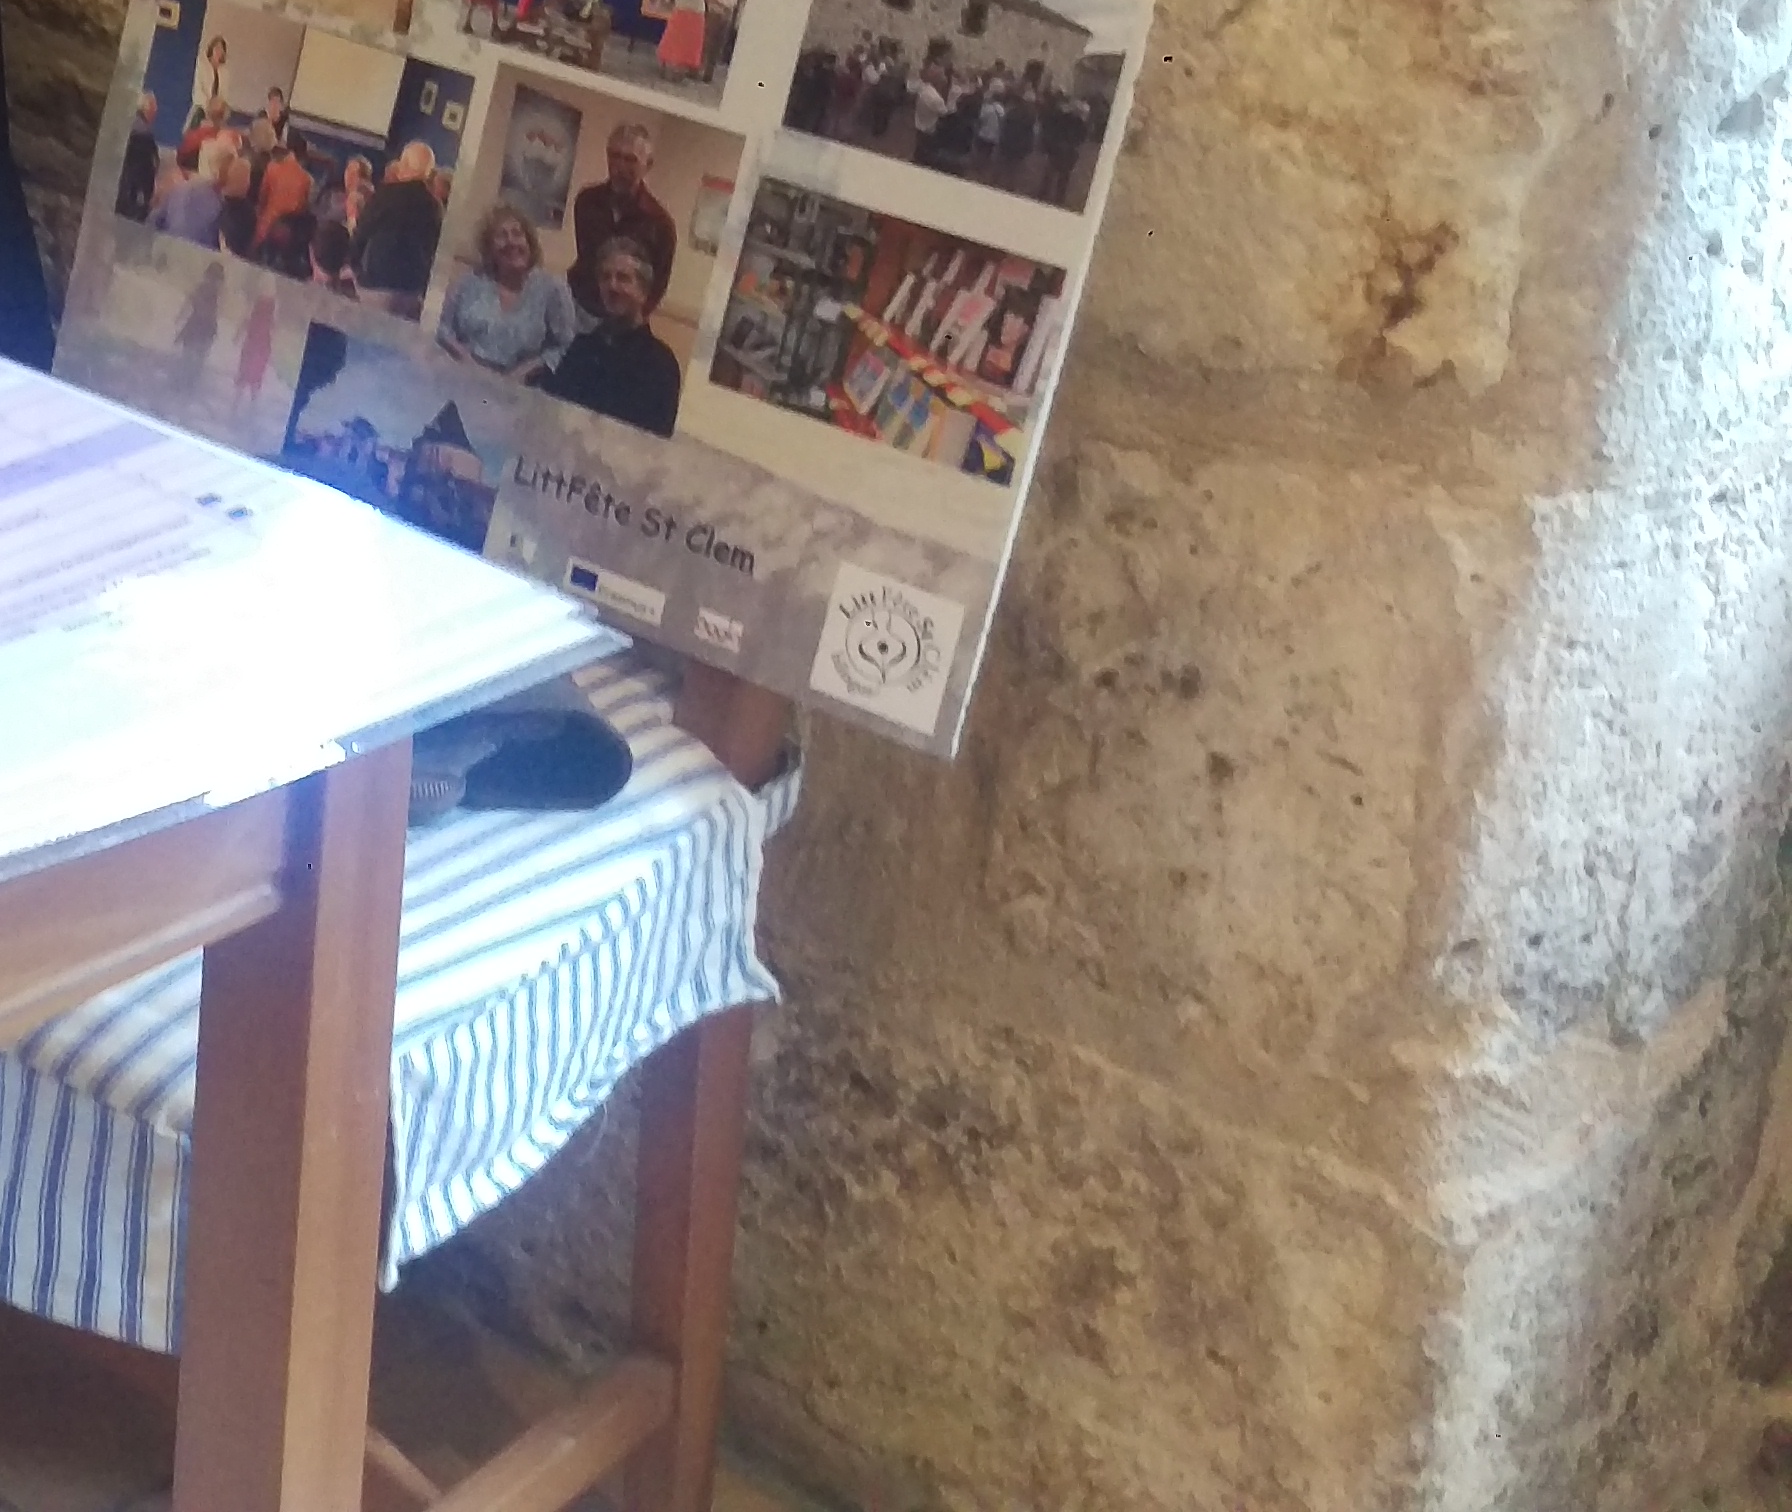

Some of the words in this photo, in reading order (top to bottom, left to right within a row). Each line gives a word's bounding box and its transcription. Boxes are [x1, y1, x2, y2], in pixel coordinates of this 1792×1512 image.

[512, 454, 632, 532] LittFête
[639, 506, 679, 545] St
[684, 524, 757, 577] Clem
